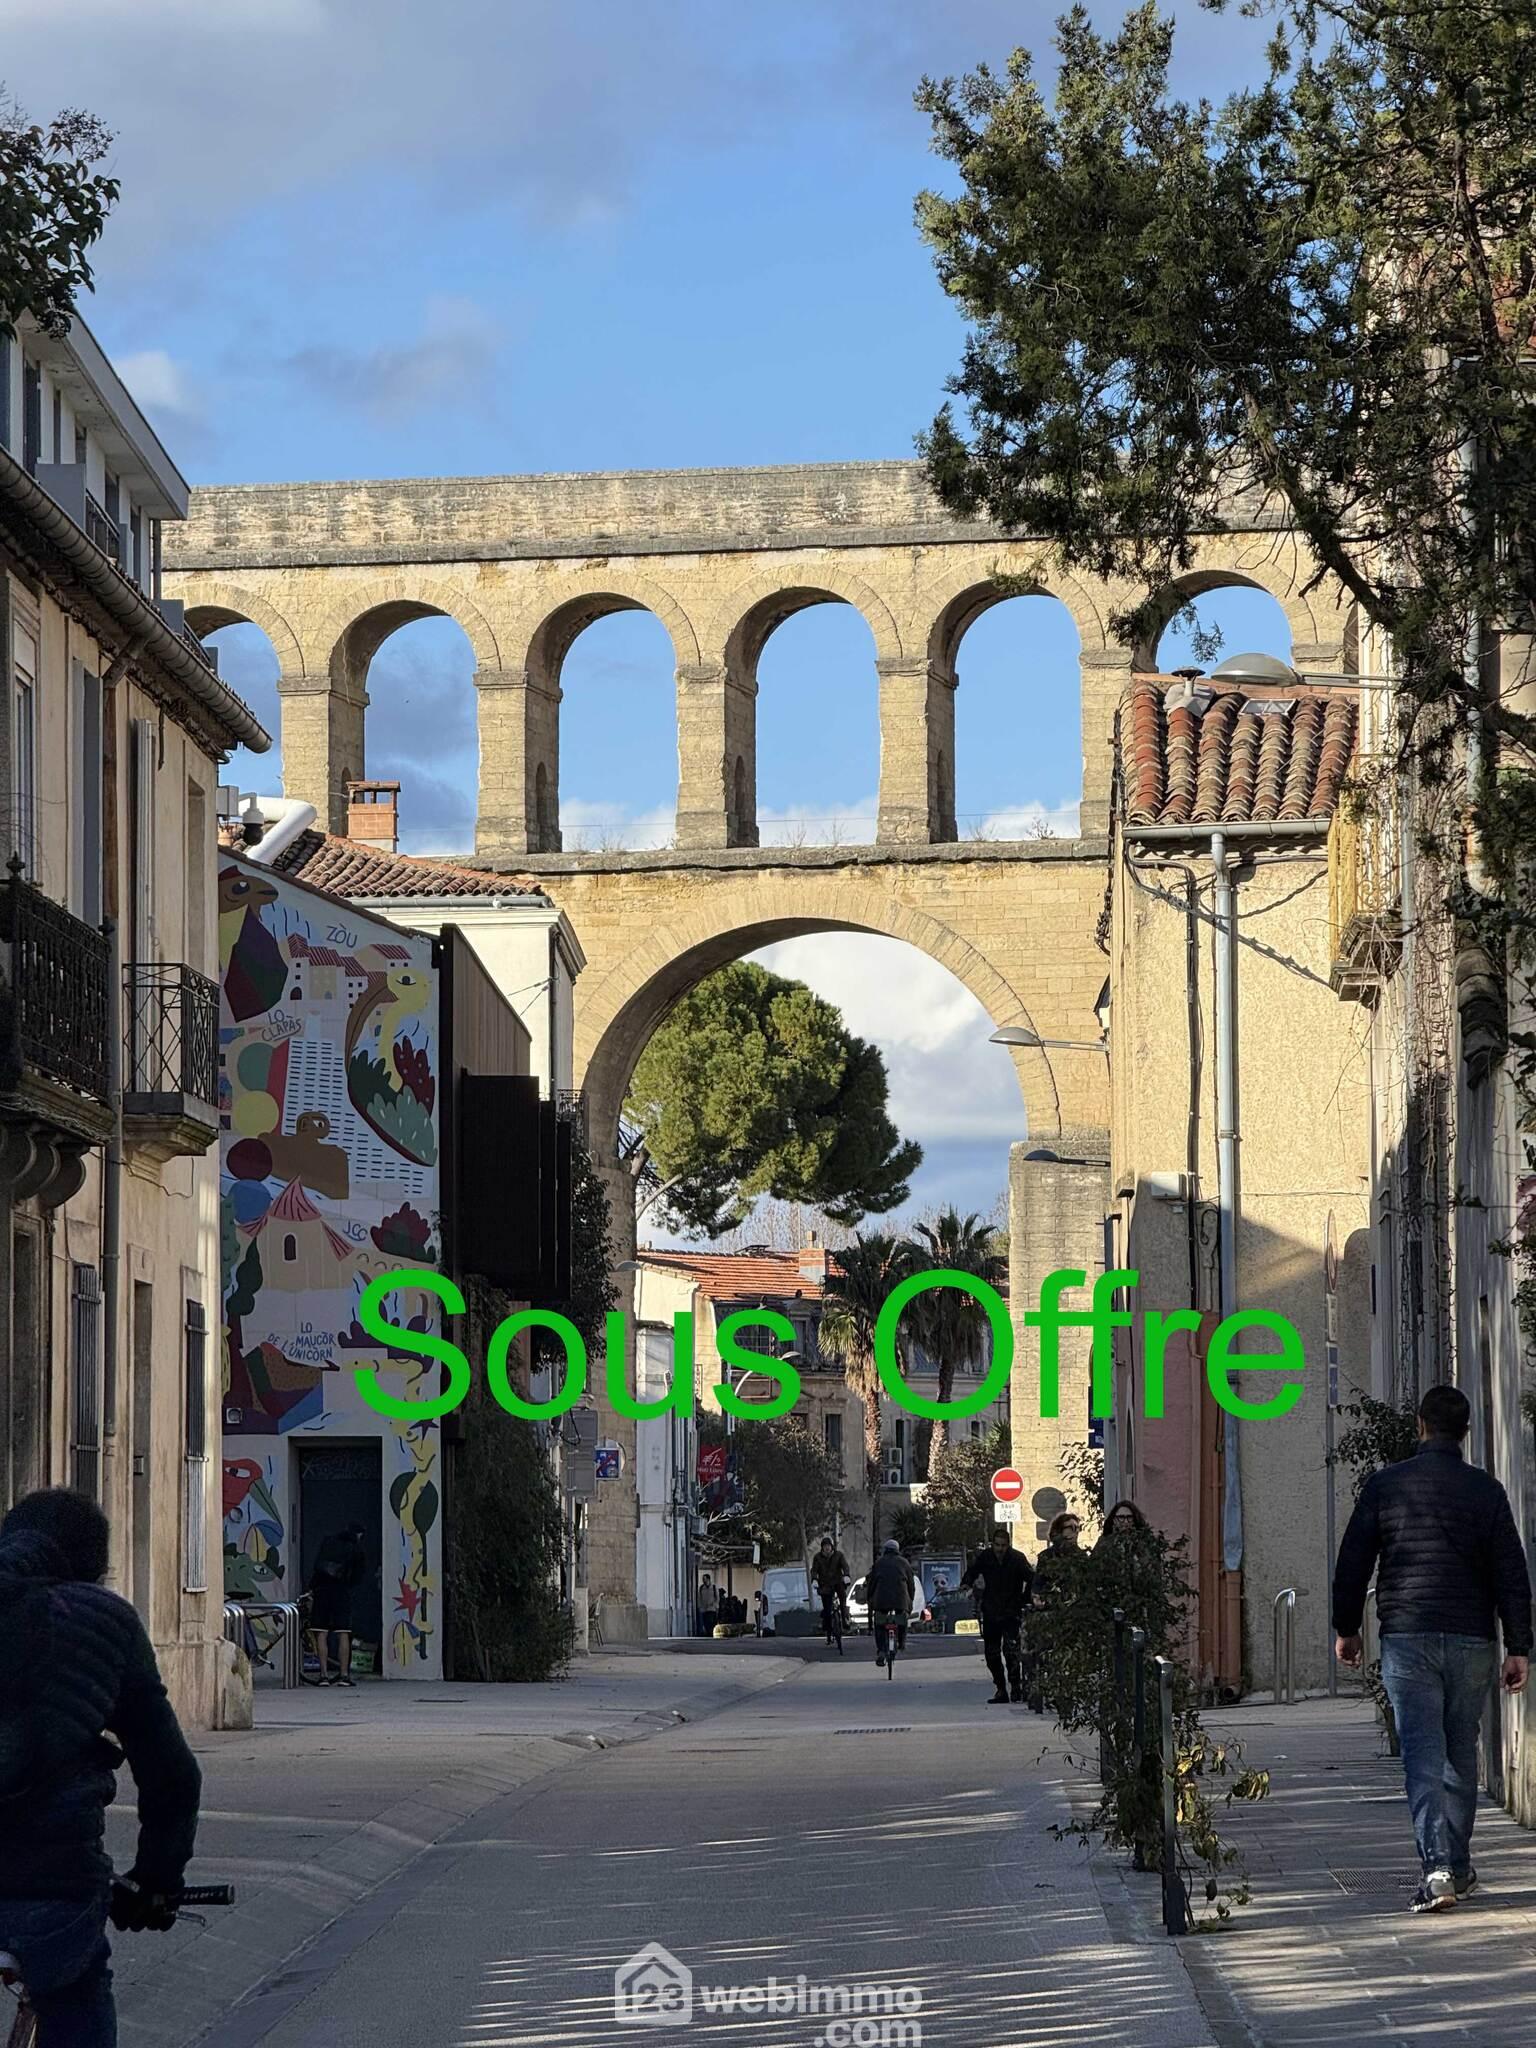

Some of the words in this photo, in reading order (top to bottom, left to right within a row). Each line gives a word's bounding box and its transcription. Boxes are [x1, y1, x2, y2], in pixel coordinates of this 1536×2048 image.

[326, 922, 358, 948] ZÒU
[267, 1009, 285, 1024] LO
[300, 1322, 313, 1334] LO
[267, 1332, 281, 1346] DE
